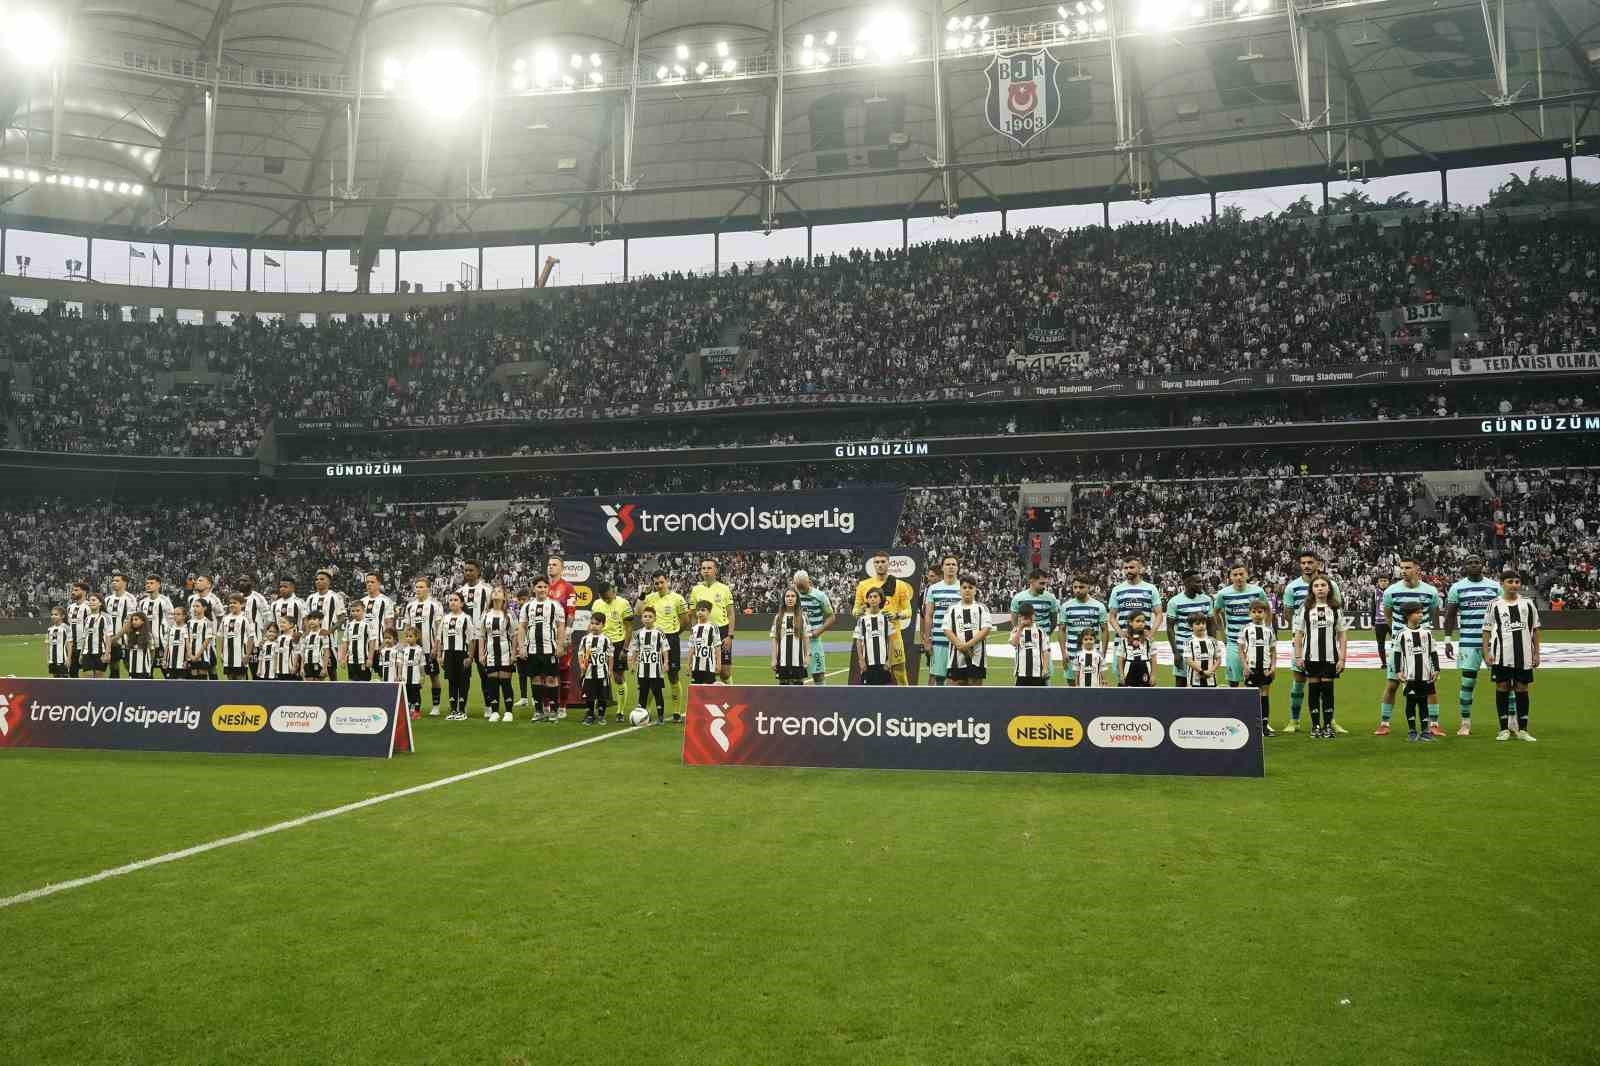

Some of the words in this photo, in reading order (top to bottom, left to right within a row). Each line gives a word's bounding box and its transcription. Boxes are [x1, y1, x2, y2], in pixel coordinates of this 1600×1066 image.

[999, 60, 1044, 79] BJK
[1006, 117, 1045, 132] 1903
[1407, 304, 1442, 320] BJK
[1556, 352, 1600, 368] OLMA
[1481, 414, 1600, 433] GÜNDÜZÜM
[835, 441, 928, 457] GÜNDÜZÜM
[326, 462, 402, 476] GÜNDÜZÜM
[640, 506, 755, 535] trendyol
[31, 701, 123, 727] trendyol
[281, 709, 319, 720] trendyol
[755, 712, 882, 741] trendyol
[1100, 721, 1152, 733] trendyol
[1196, 729, 1227, 737] Telekom
[1110, 734, 1143, 743] yemek
